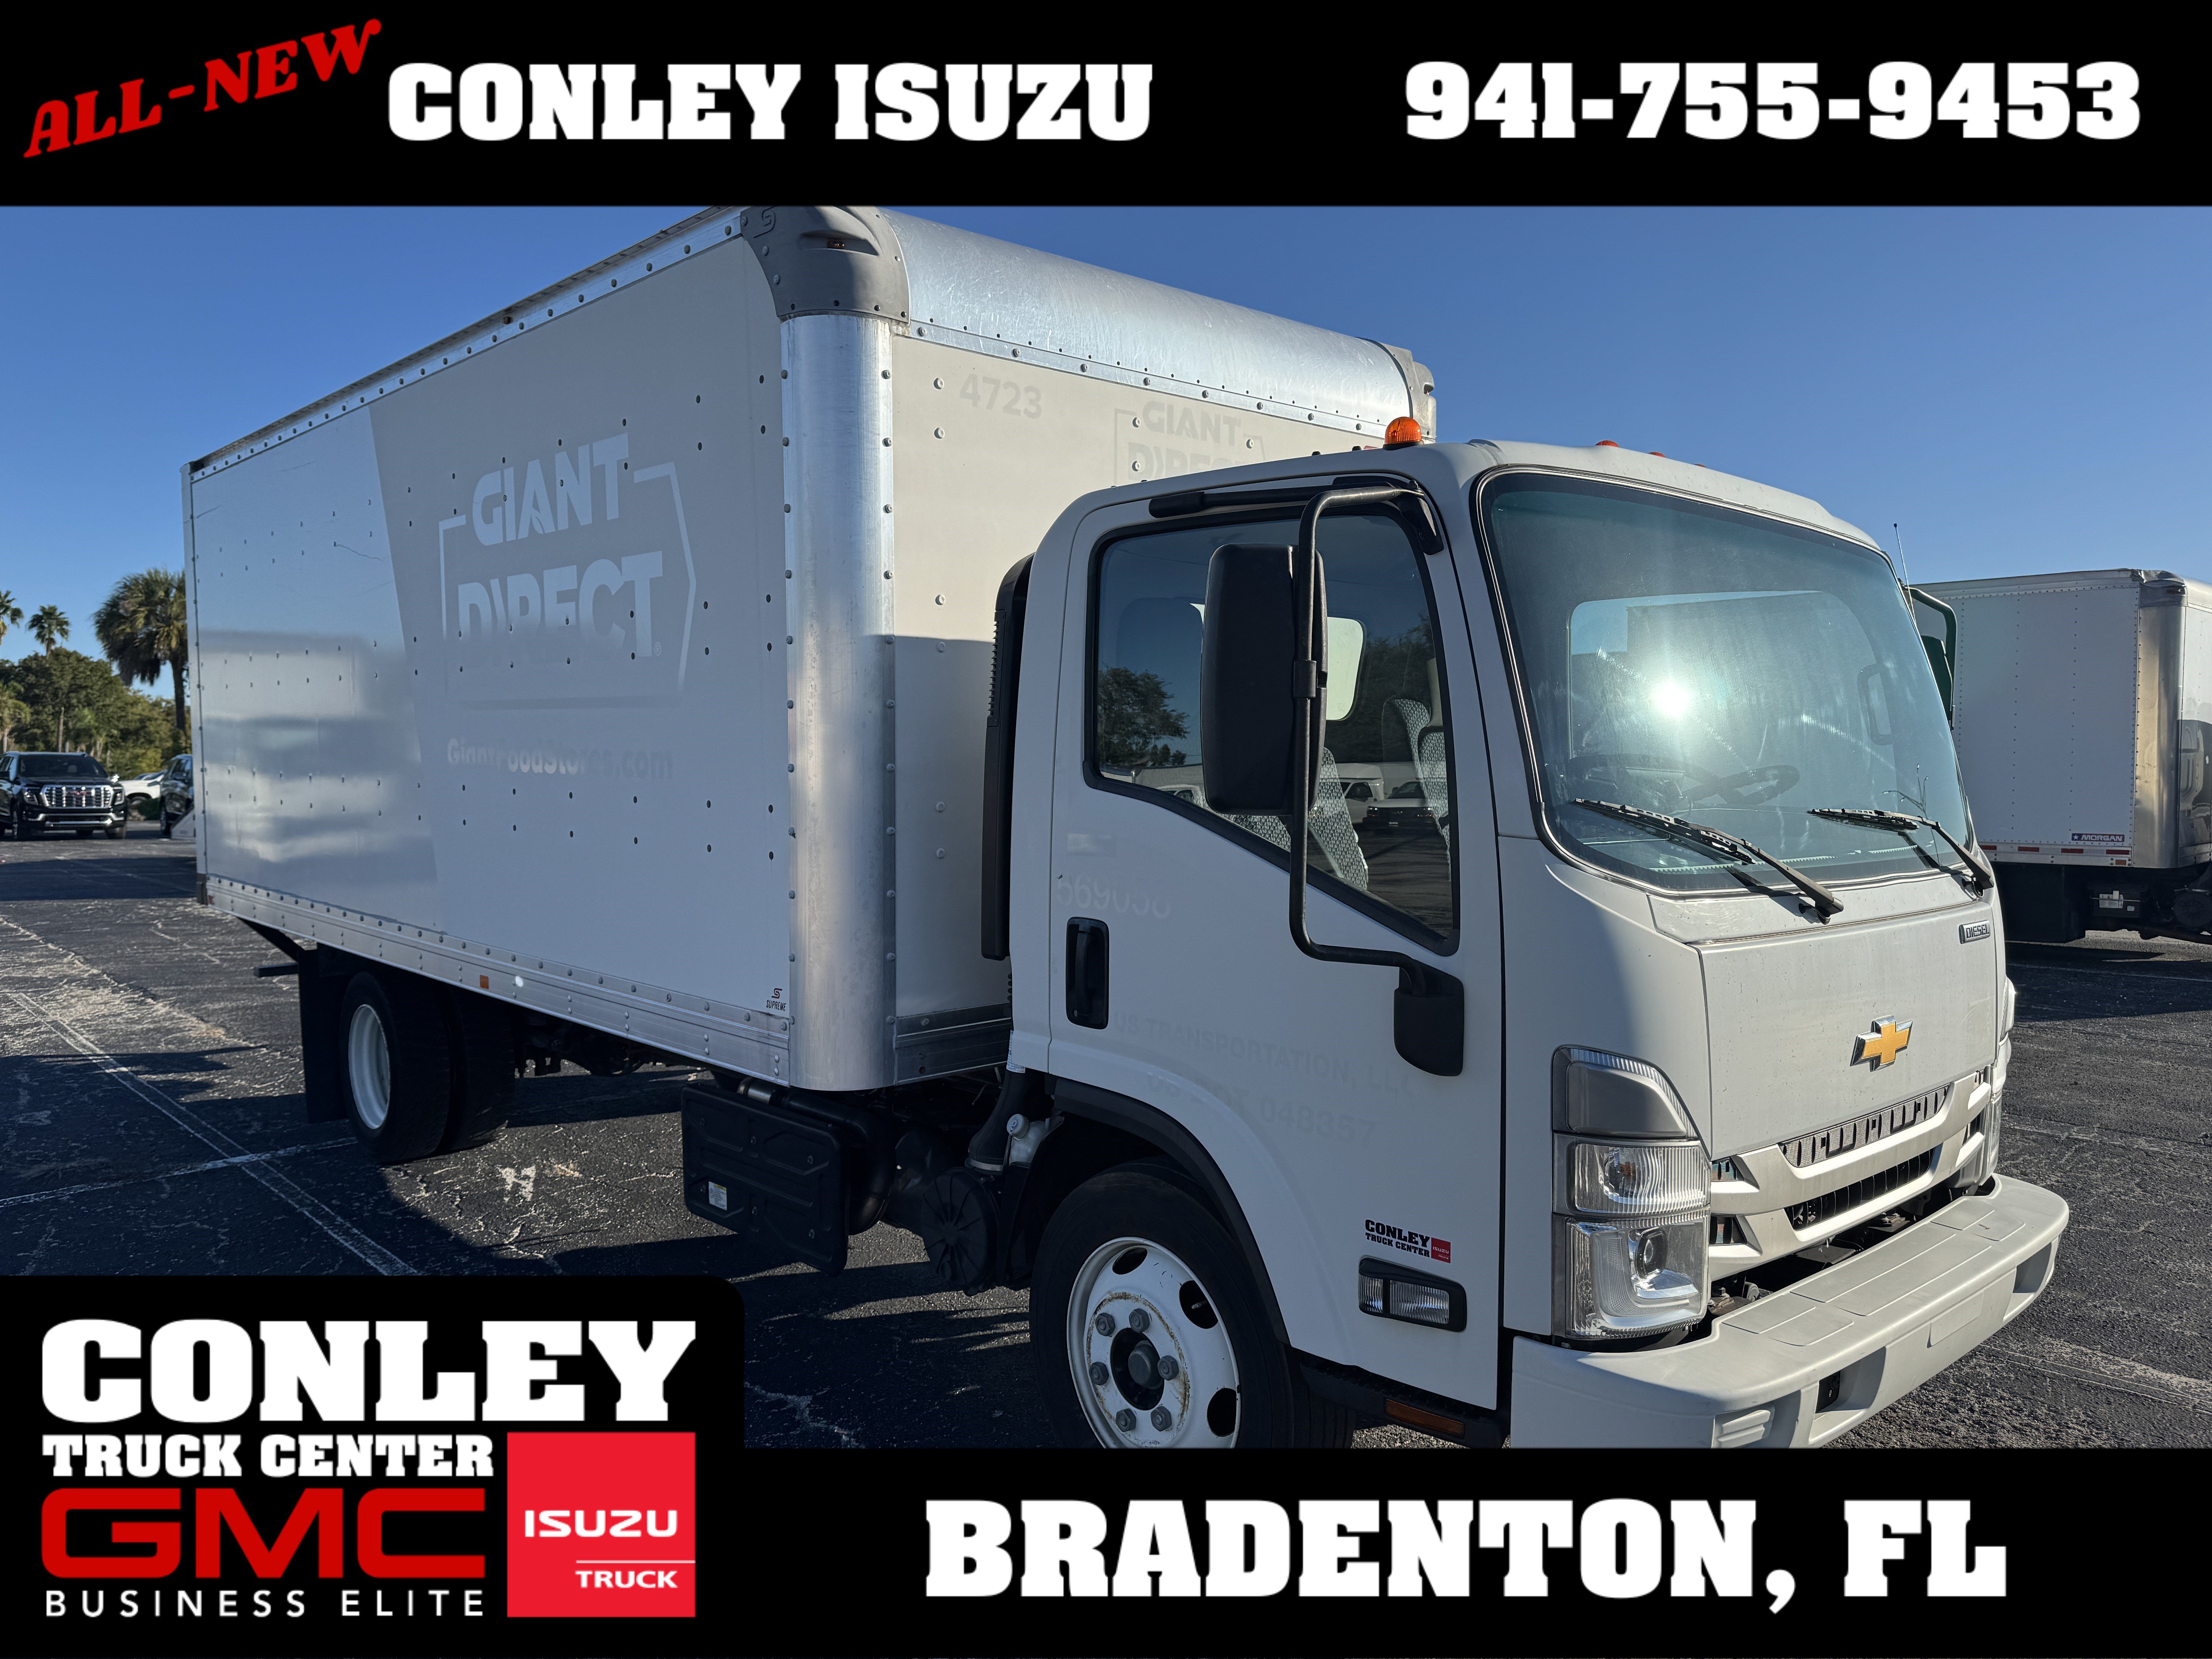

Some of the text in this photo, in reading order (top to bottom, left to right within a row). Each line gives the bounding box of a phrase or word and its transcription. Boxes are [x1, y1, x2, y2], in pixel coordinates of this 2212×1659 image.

[960, 373, 1042, 419] 4723
[1142, 400, 1242, 447] GIANT
[472, 432, 629, 546] GIANT
[458, 550, 663, 669] DIRECT
[1965, 924, 1989, 939] DIESEL
[766, 1000, 787, 1012] SUPREME
[1365, 1219, 1430, 1248] CONLEY
[1365, 1232, 1430, 1258] TRUCK CENTER
[1433, 1246, 1449, 1254] ISUZU
